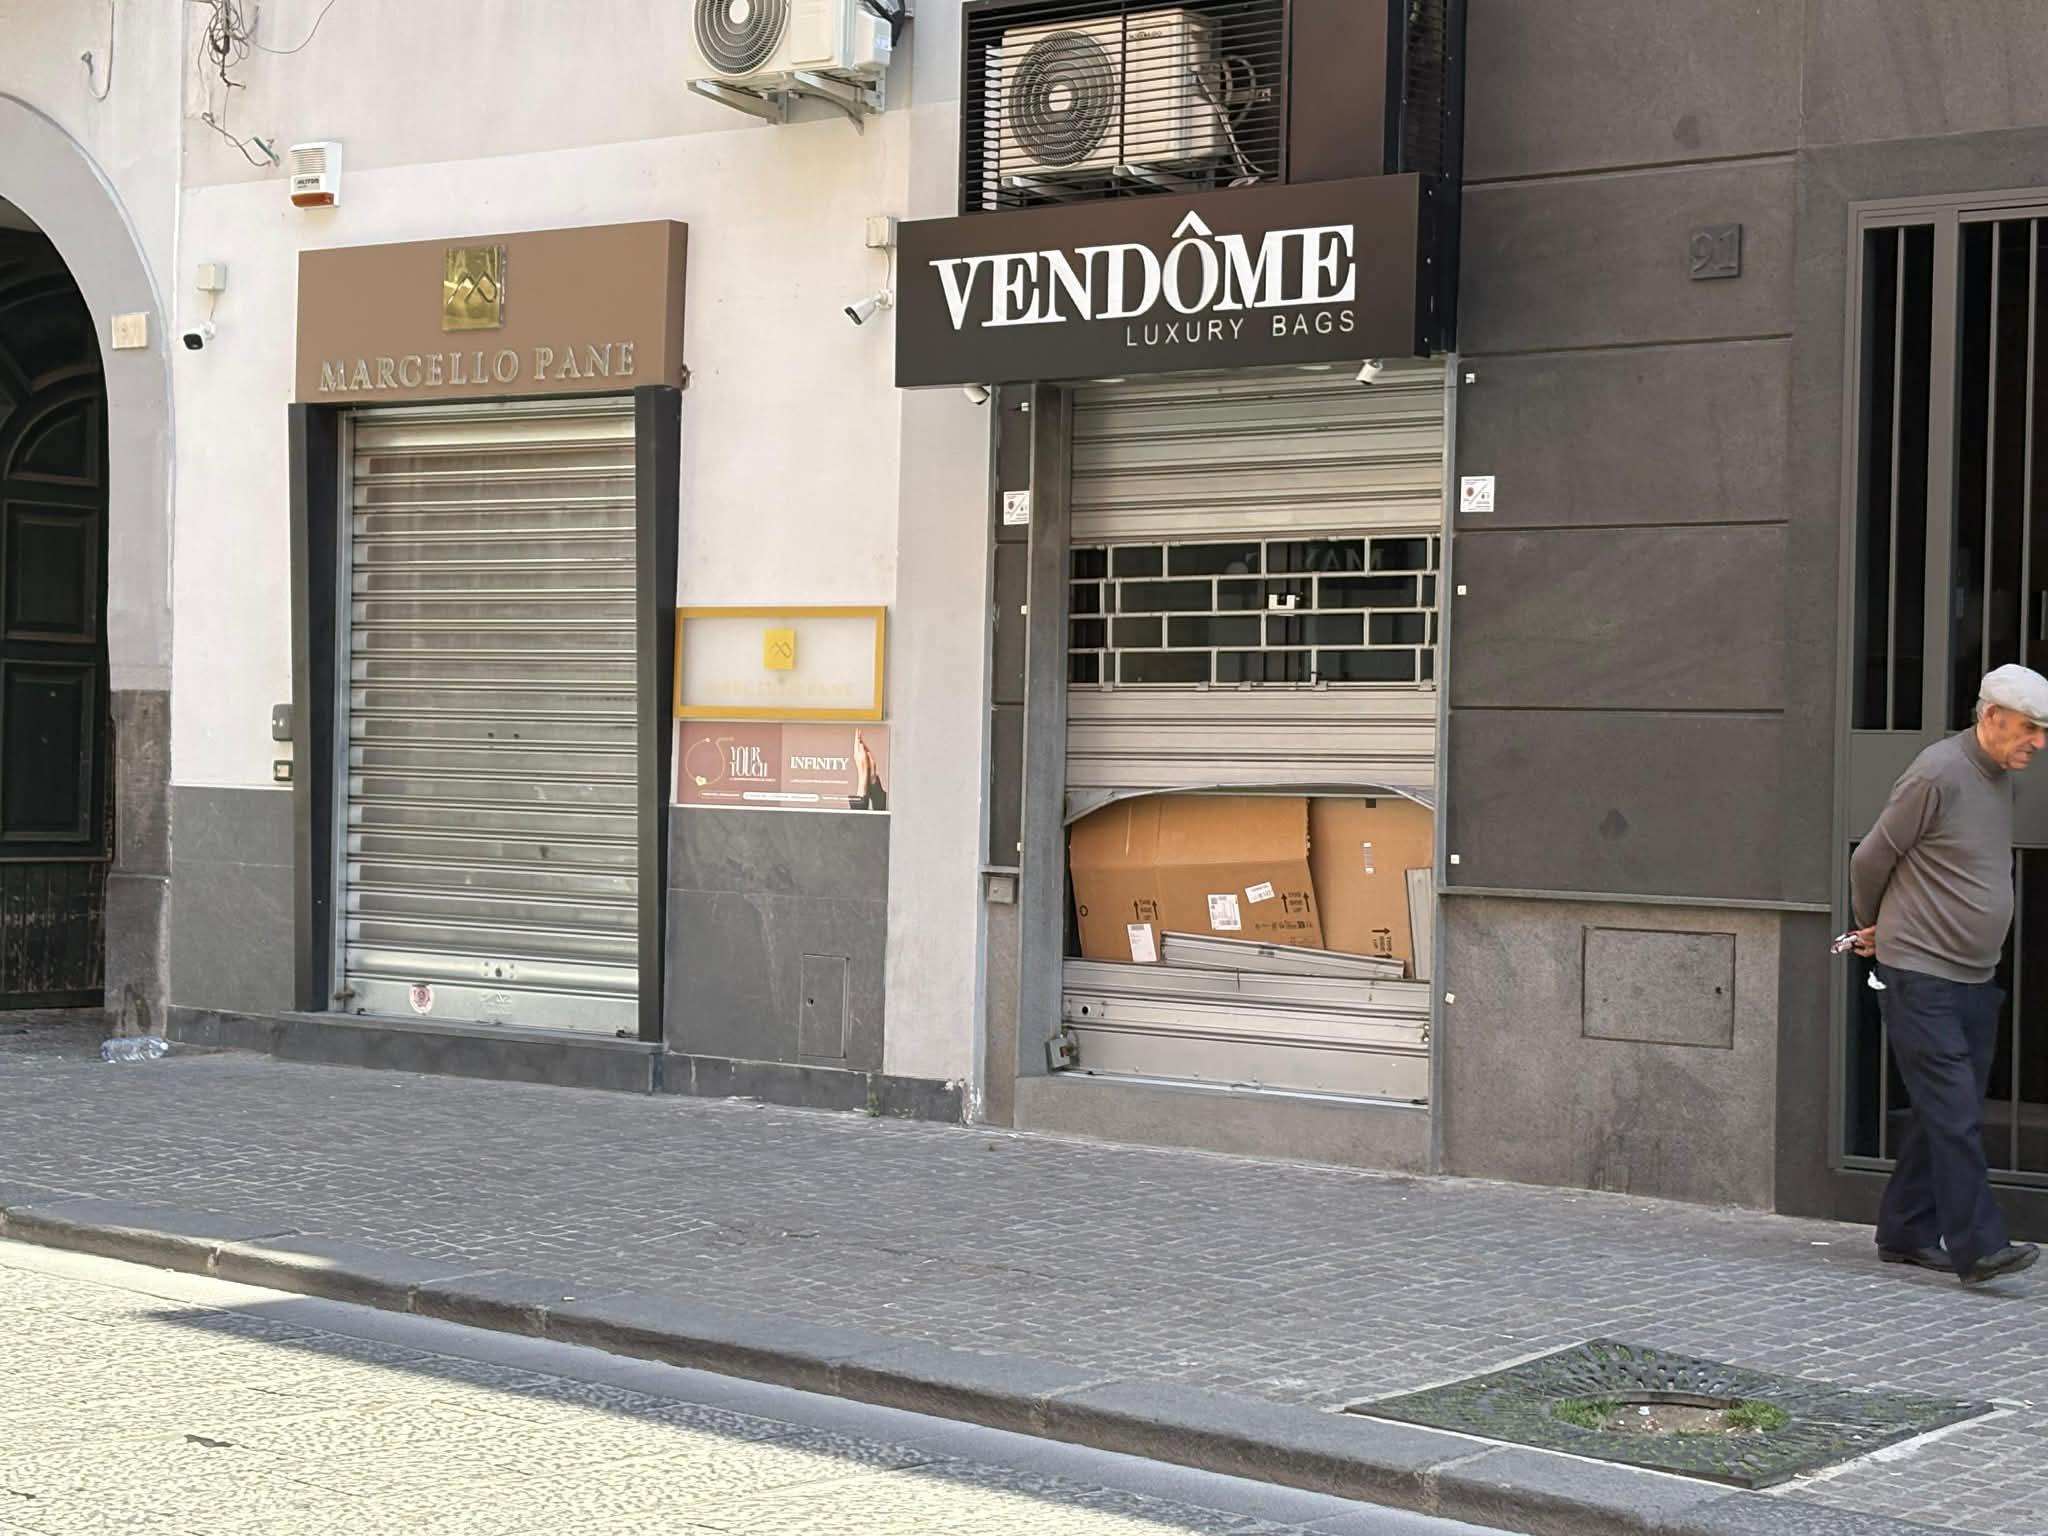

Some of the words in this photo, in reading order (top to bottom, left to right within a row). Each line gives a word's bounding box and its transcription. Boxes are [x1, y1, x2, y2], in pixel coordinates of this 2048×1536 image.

[929, 210, 1356, 331] VENDÔME
[1126, 318, 1245, 347] LUXURY
[1272, 310, 1355, 337] BAGS
[319, 350, 519, 392] MARCELLO
[533, 341, 635, 381] PANE
[790, 756, 848, 770] INFINITY
